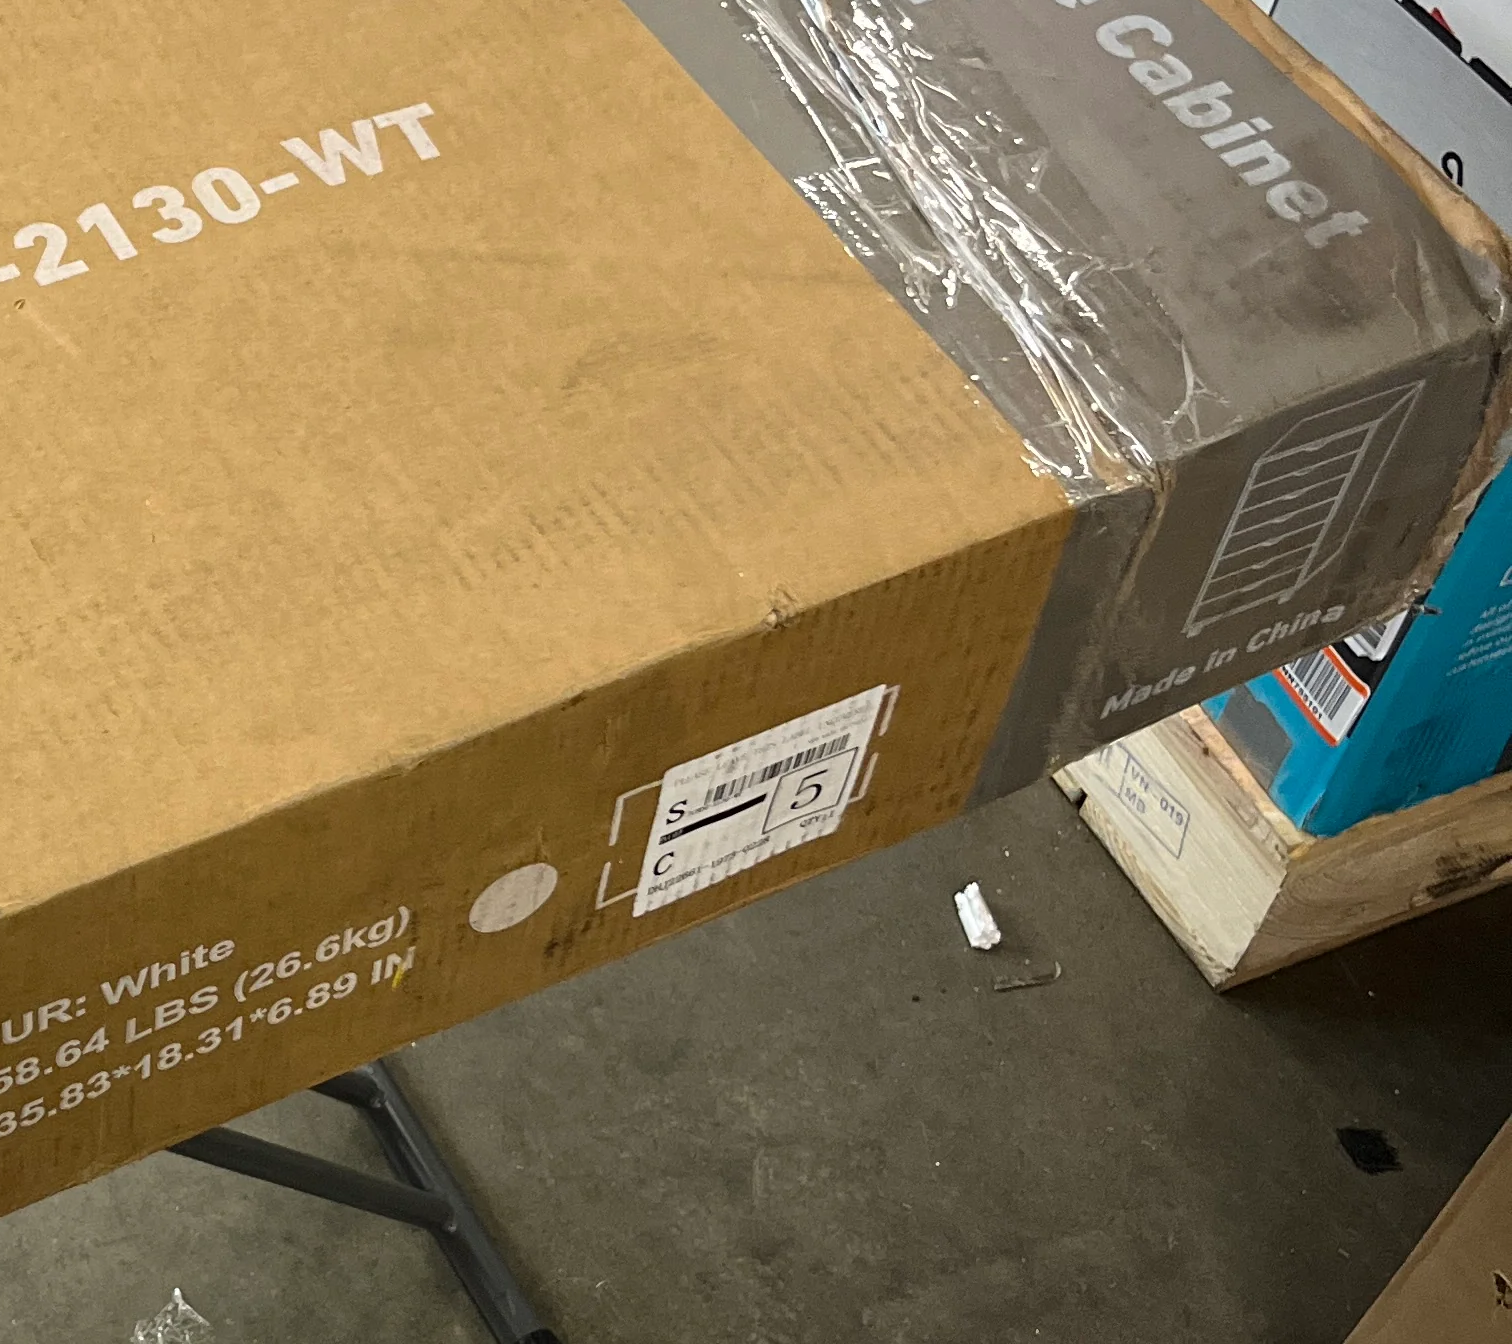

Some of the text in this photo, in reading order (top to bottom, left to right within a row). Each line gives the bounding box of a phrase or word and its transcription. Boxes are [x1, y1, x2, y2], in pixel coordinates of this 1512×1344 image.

[1095, 13, 1370, 250] Cabinet
[1100, 602, 1346, 720] Made in China
[665, 799, 689, 826] S
[788, 768, 829, 811] 5
[652, 852, 676, 878] C
[99, 937, 236, 1006] White
[122, 984, 220, 1044] LBS
[233, 905, 412, 1003] (26.6kg)
[369, 946, 416, 988] IN
